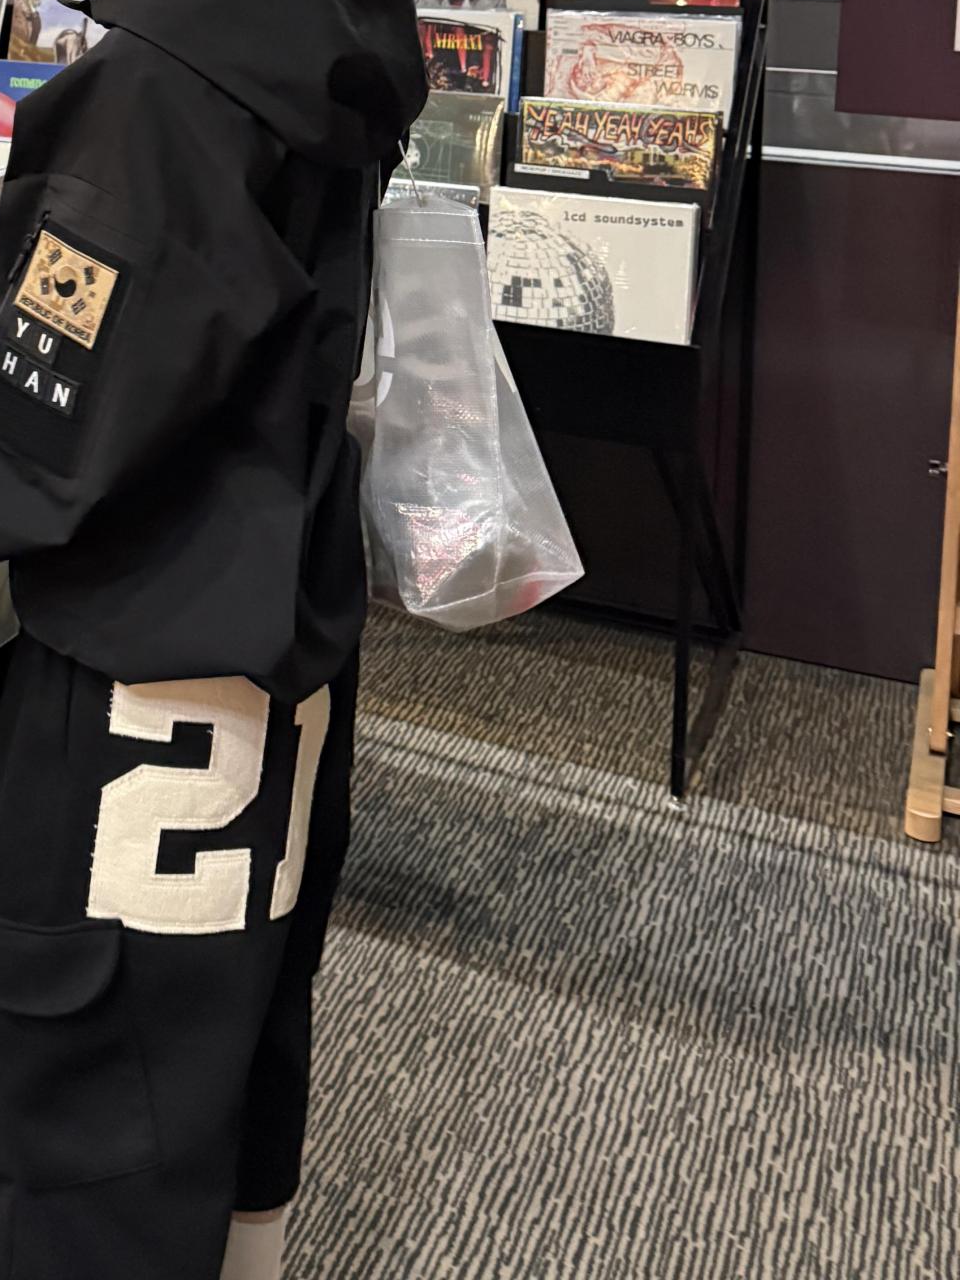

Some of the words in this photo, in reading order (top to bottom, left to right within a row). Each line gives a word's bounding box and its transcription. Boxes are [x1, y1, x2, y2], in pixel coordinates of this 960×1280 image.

[608, 29, 665, 46] VIAGRA
[673, 32, 715, 49] BOYS
[654, 80, 719, 99] WORMS
[527, 104, 589, 140] YEAH
[593, 111, 641, 145] YEAH
[648, 117, 716, 150] YEAHS
[563, 211, 586, 223] lcd
[594, 213, 684, 228] soundsystem
[86, 675, 332, 935] 21
